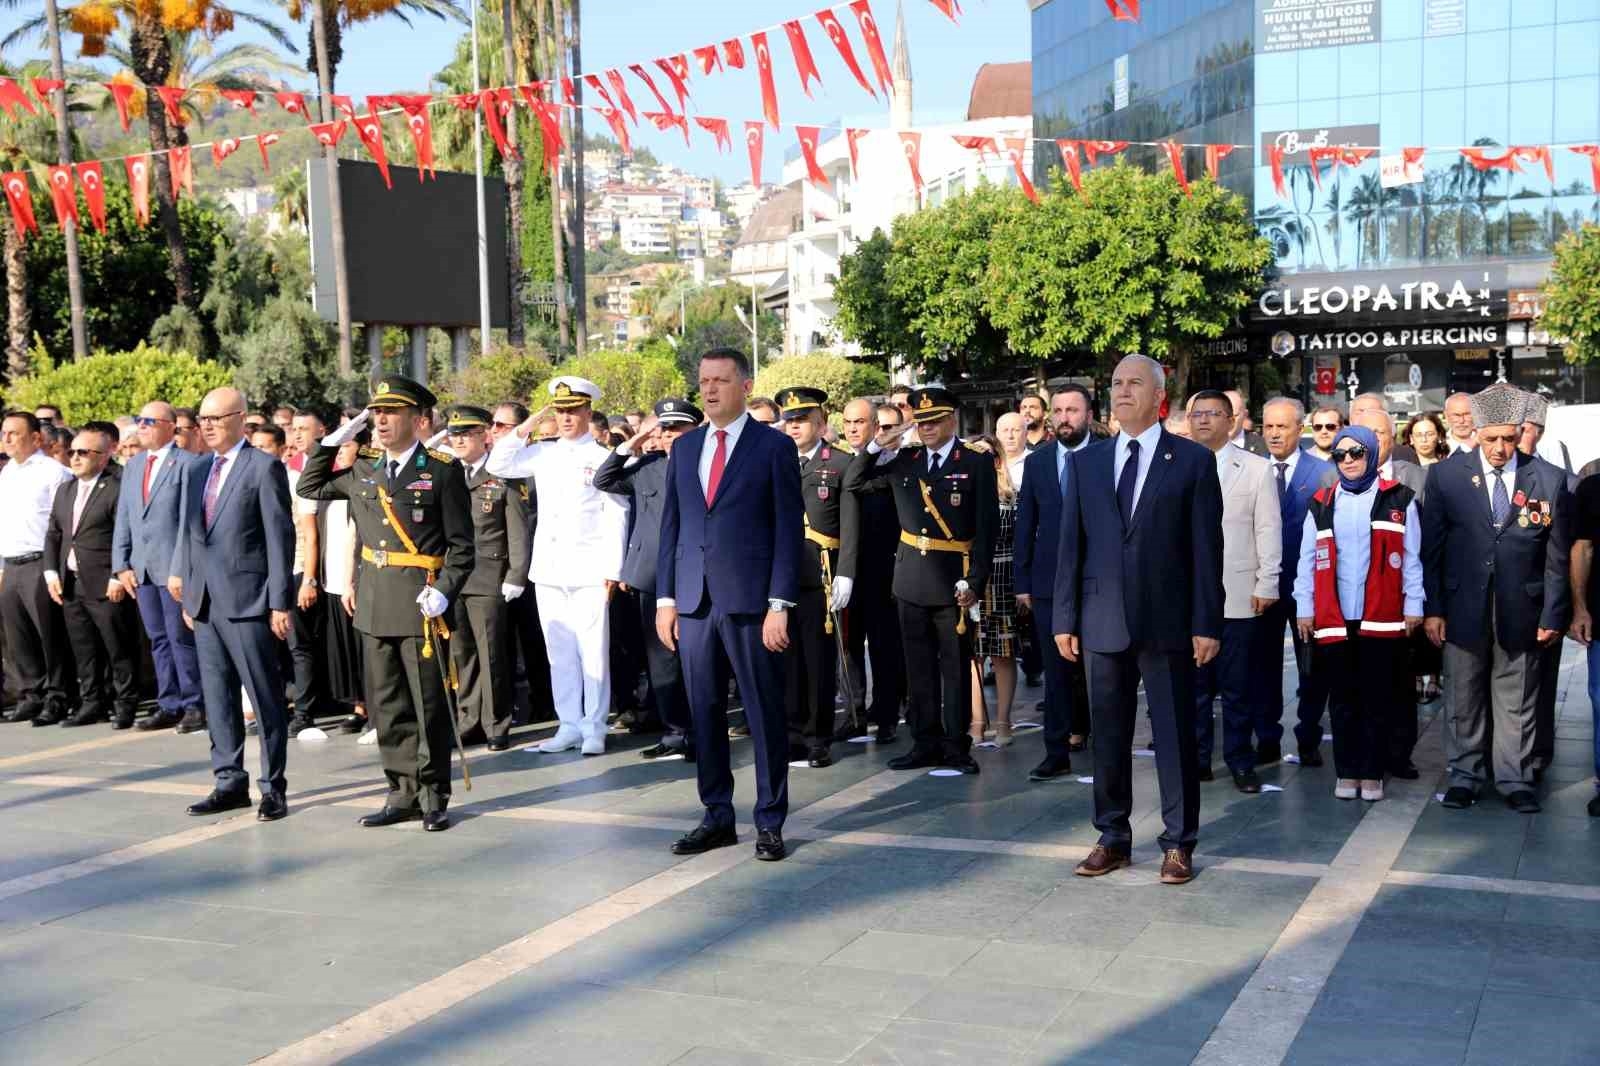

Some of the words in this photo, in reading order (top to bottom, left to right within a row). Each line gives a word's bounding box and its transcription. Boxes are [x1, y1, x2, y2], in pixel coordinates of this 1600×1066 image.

[1264, 9, 1313, 24] HUKUK
[1315, 4, 1374, 19] BÜROSU
[1258, 280, 1473, 316] CLEOPATRA
[1300, 332, 1379, 350] TATTOO
[1382, 331, 1398, 347] &
[1401, 326, 1497, 346] PIERCING
